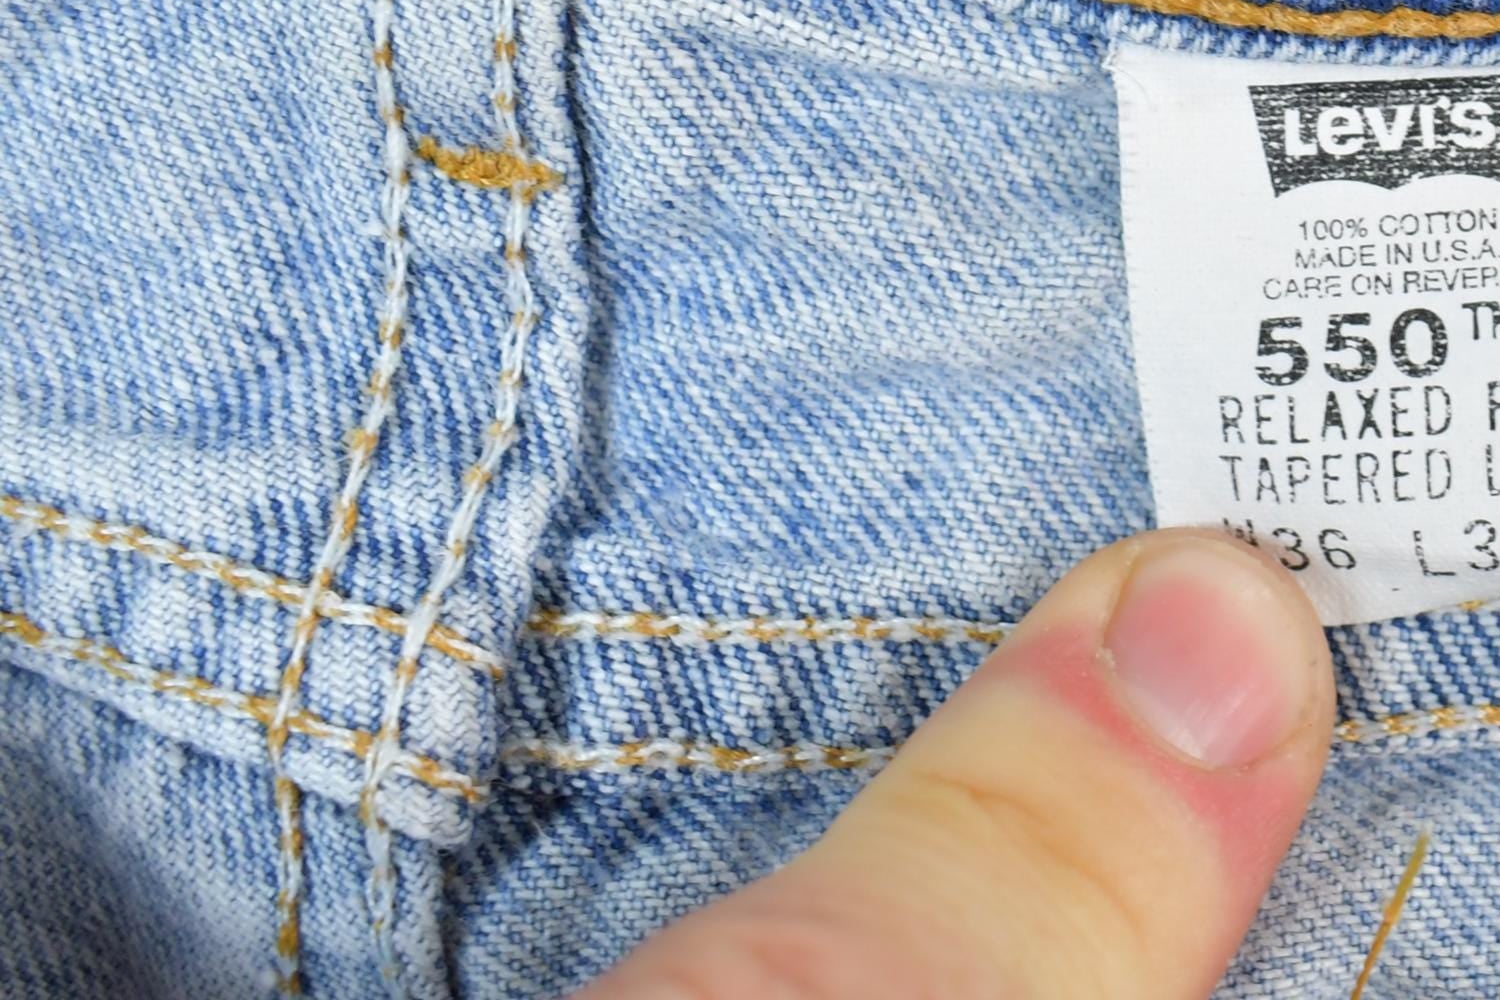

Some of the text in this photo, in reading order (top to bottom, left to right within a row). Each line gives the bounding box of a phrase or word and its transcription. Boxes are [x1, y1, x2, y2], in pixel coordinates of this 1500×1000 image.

[1298, 208, 1499, 241] 100% COTTON
[1294, 244, 1377, 269] MADE
[1385, 243, 1413, 265] IN
[1262, 275, 1343, 300] CARE
[1351, 272, 1393, 296] ON
[1218, 384, 1452, 445] RELAXED
[1218, 448, 1452, 505] TAPERED
